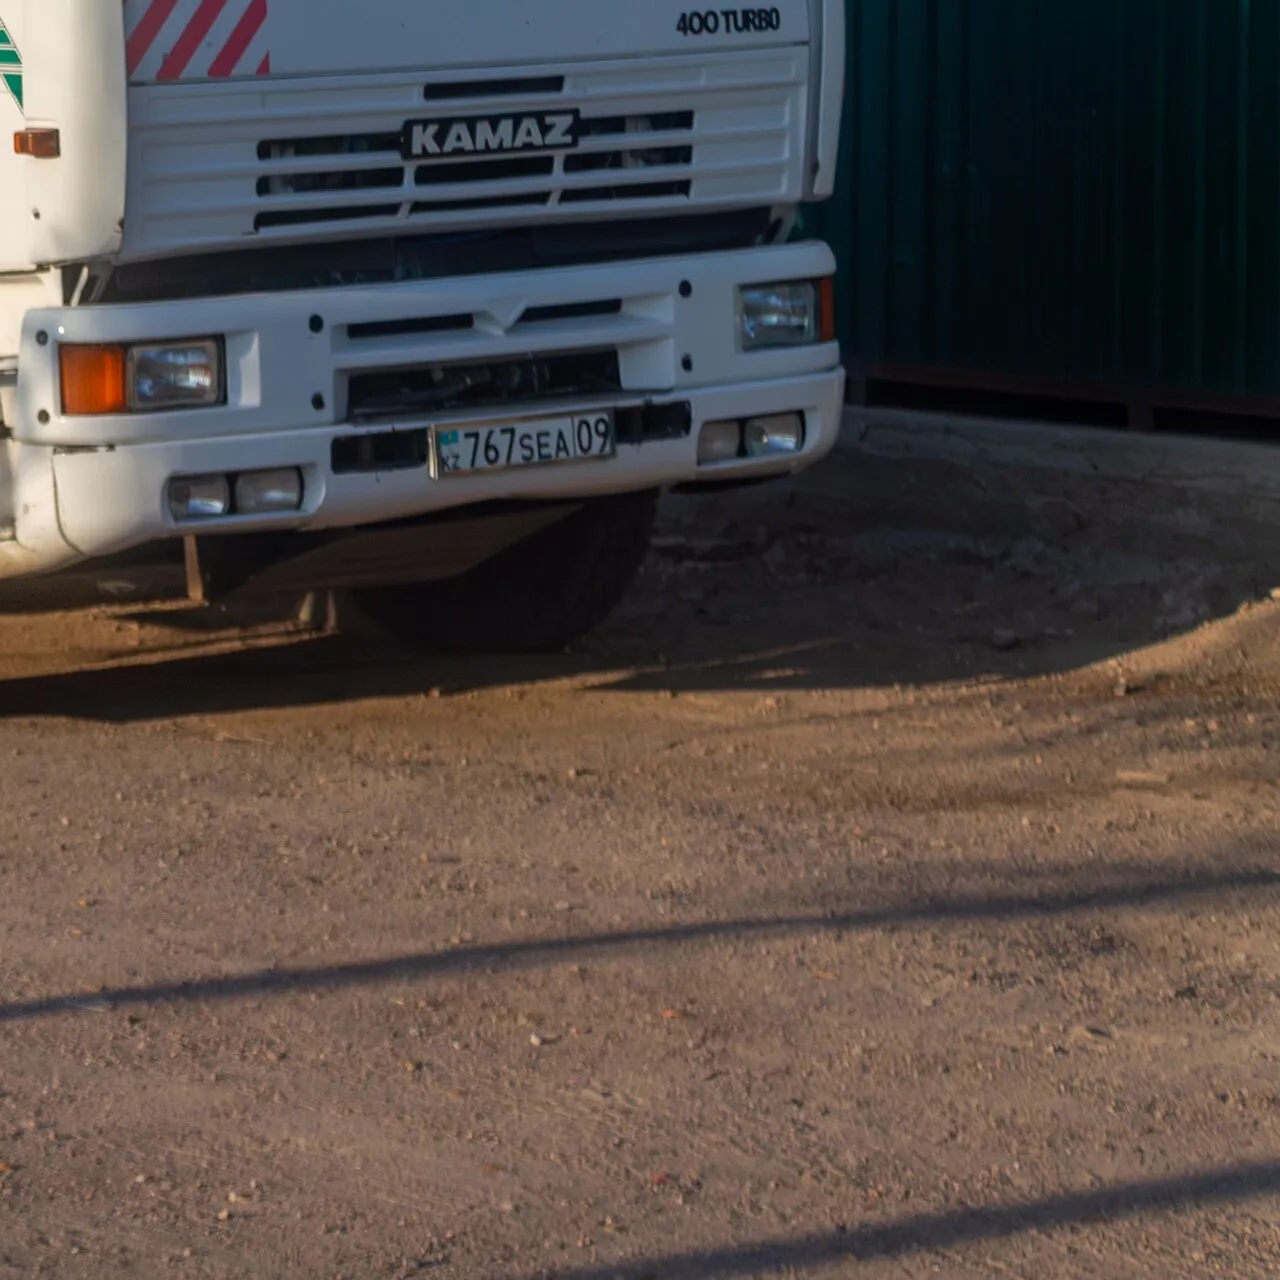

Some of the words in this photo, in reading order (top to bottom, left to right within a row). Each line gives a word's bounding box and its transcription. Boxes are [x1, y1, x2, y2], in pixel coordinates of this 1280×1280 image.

[676, 10, 720, 37] 400
[720, 6, 781, 33] TURBO
[411, 113, 575, 156] KAMAZ
[577, 417, 610, 455] 09
